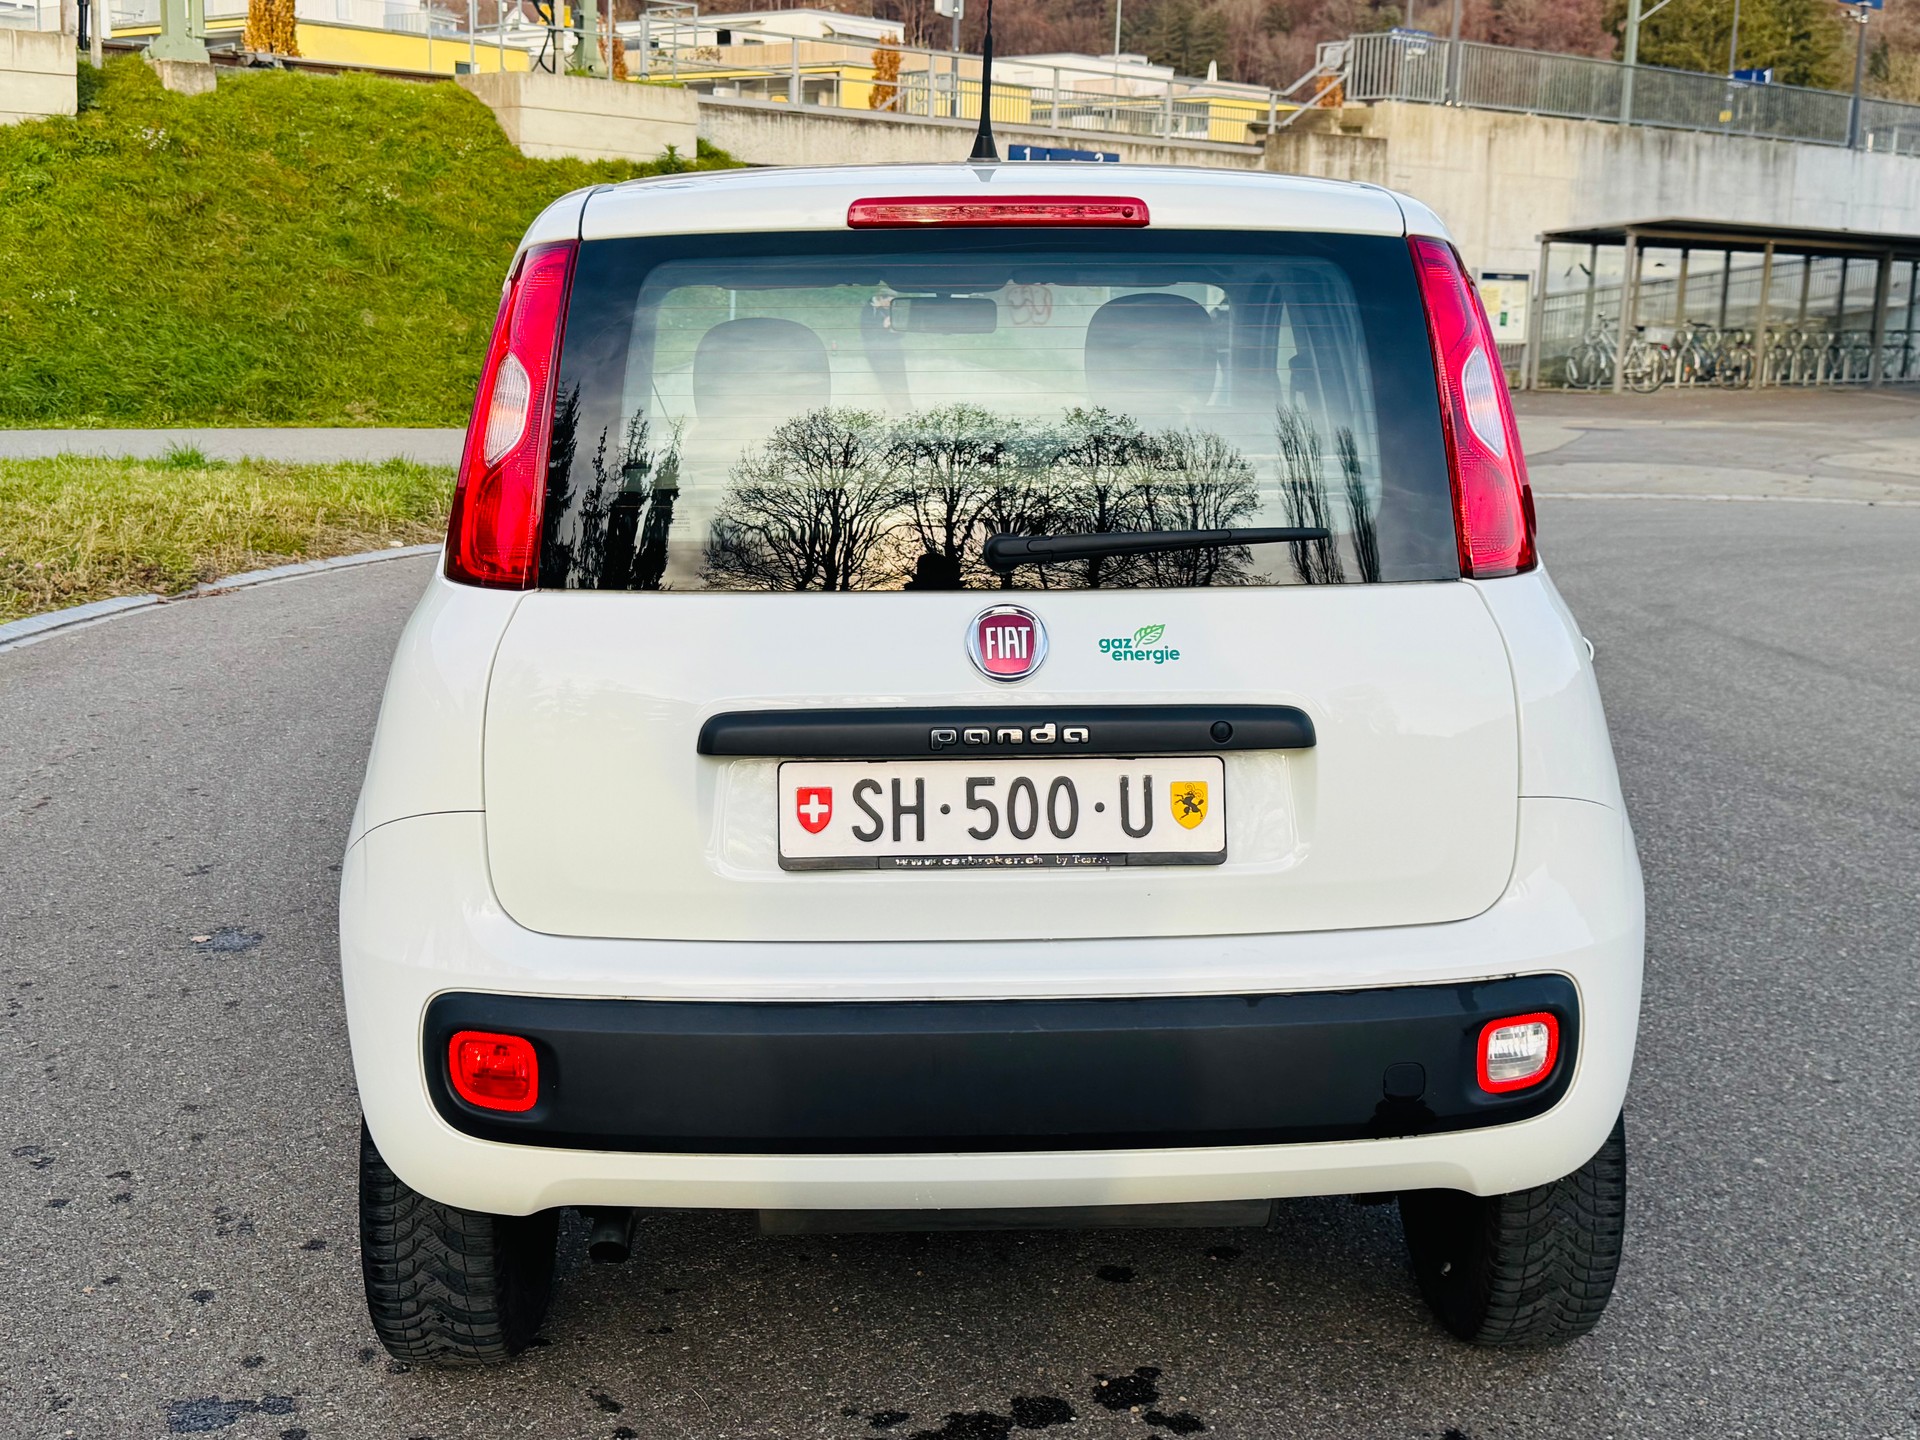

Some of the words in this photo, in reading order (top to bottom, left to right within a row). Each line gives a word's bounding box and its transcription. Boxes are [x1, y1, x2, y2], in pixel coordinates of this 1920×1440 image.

[1023, 147, 1031, 161] 1
[985, 626, 1031, 660] FIAT
[1099, 637, 1133, 653] gaz
[1112, 646, 1180, 664] energie
[931, 723, 1089, 750] panda
[1056, 855, 1068, 866] by
